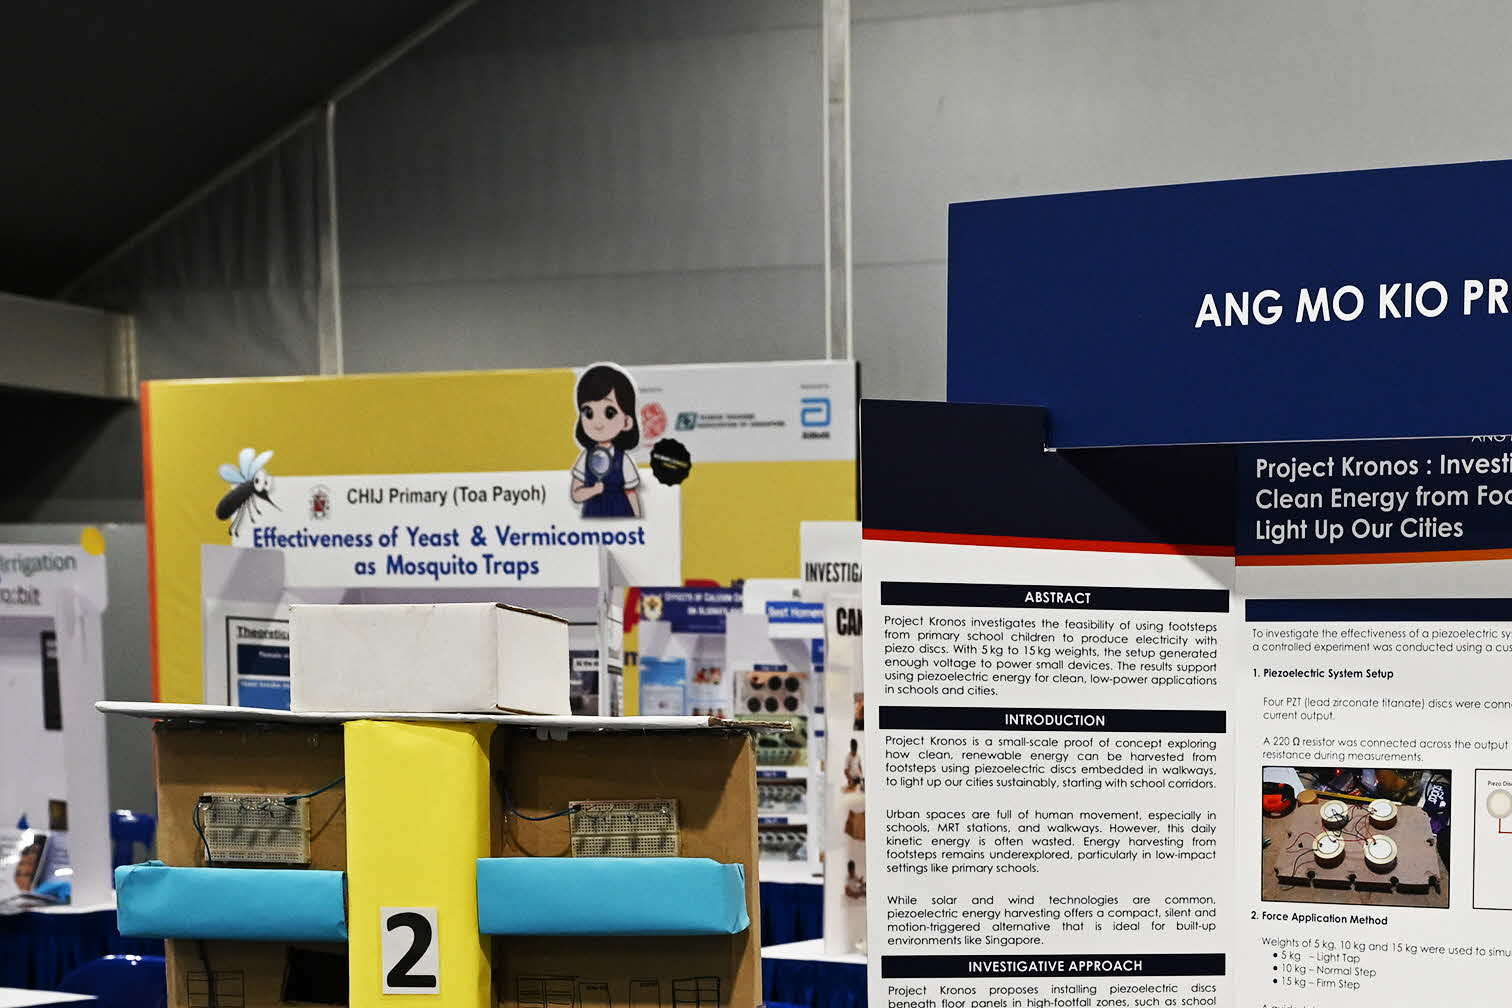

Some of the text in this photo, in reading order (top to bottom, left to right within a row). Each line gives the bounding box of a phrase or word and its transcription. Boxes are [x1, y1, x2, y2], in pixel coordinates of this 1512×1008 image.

[1194, 288, 1283, 329] ANG
[1294, 284, 1364, 323] MO
[1378, 280, 1448, 319] KIO
[1256, 456, 1335, 483] Project
[1341, 455, 1419, 477] Kronos
[1426, 459, 1432, 475] :
[346, 484, 546, 508] CHIJ Primary (Toa Payoh)
[1255, 488, 1323, 510] Clean
[1330, 487, 1410, 512] Energy
[1414, 485, 1469, 507] from
[252, 525, 646, 550] Effectiveness of Yeast & Vermicompost
[1255, 516, 1464, 545] Light Up Our Cities
[354, 552, 540, 582] as Mosquito Traps
[1024, 591, 1091, 604] ABSTRACT
[884, 615, 1217, 634] Project Kronos investigates the feasibility of using footsteps
[1253, 668, 1394, 680] 1. Piezoelectric System Setup
[1005, 713, 1105, 726] INTRODUCTION
[1250, 910, 1388, 925] 2. Force Application Method
[386, 912, 436, 988] 2
[968, 959, 1142, 972] INVESTIGATIVE APPROACH
